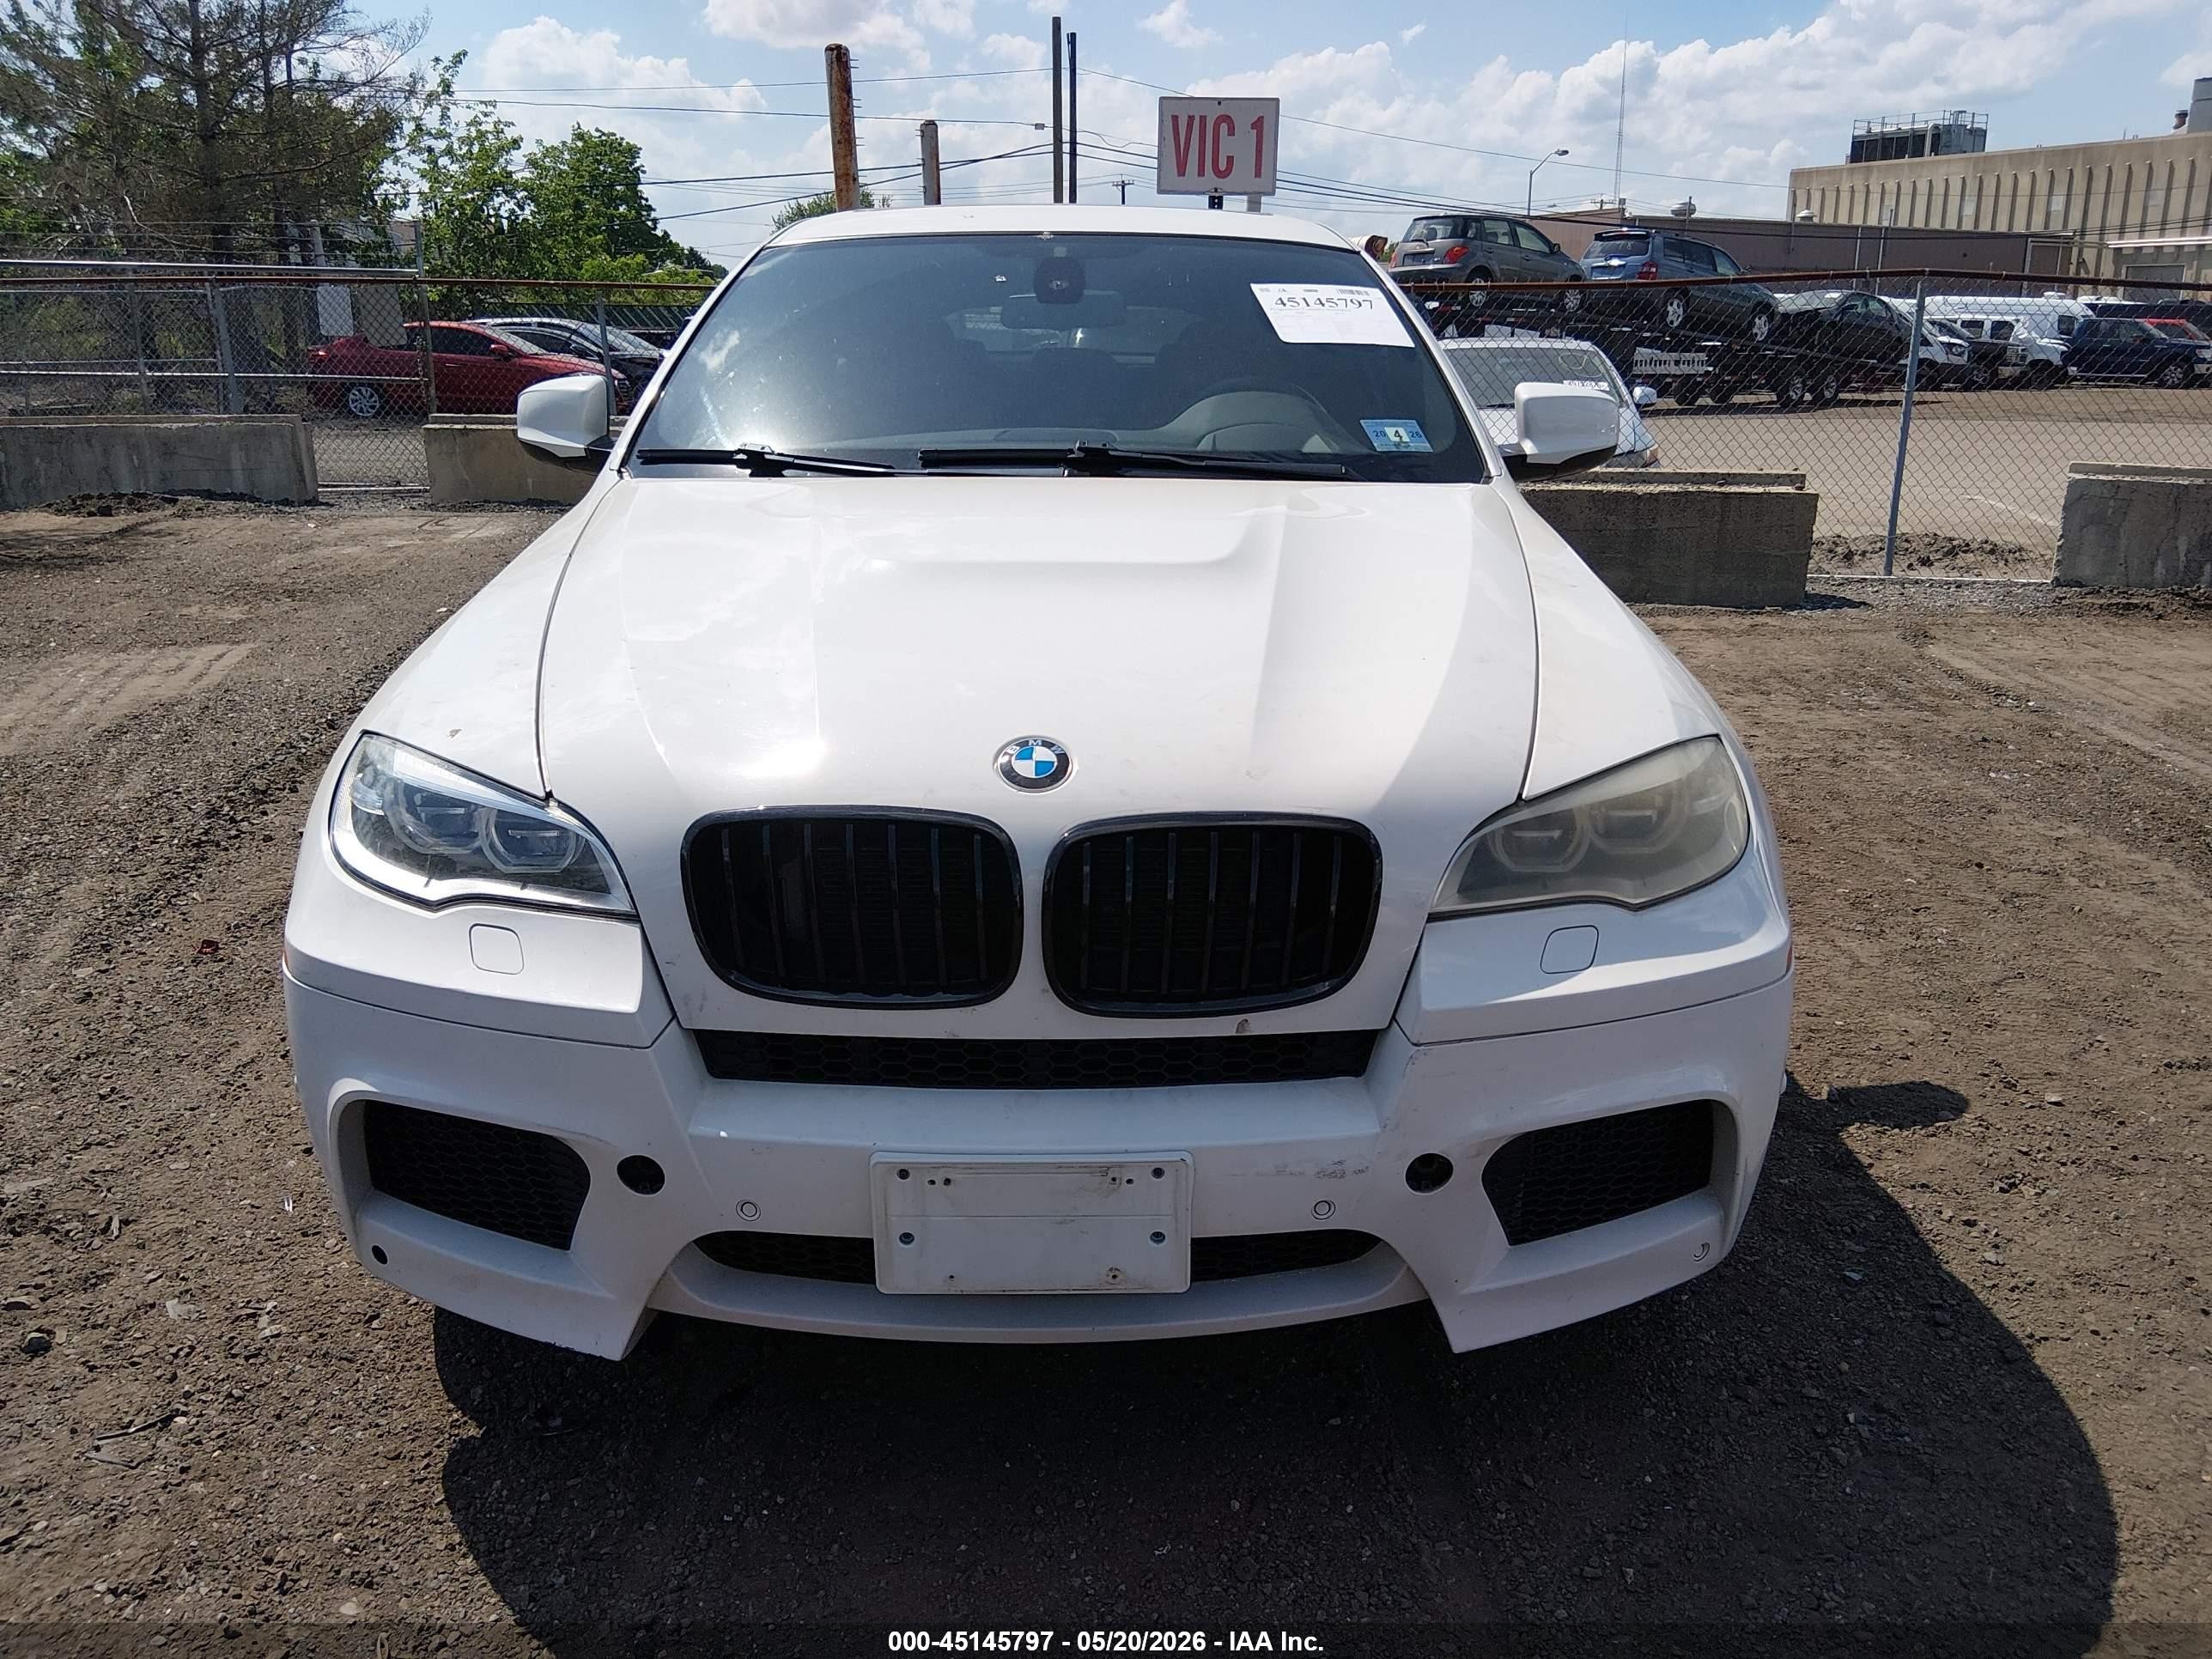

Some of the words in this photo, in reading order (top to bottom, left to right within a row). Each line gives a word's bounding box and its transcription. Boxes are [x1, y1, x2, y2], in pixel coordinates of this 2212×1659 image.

[1171, 114, 1235, 179] VIC
[1250, 116, 1265, 179] 1
[1275, 296, 1374, 310] 45145797
[1394, 430, 1403, 441] 4
[1006, 739, 1065, 755] BMW
